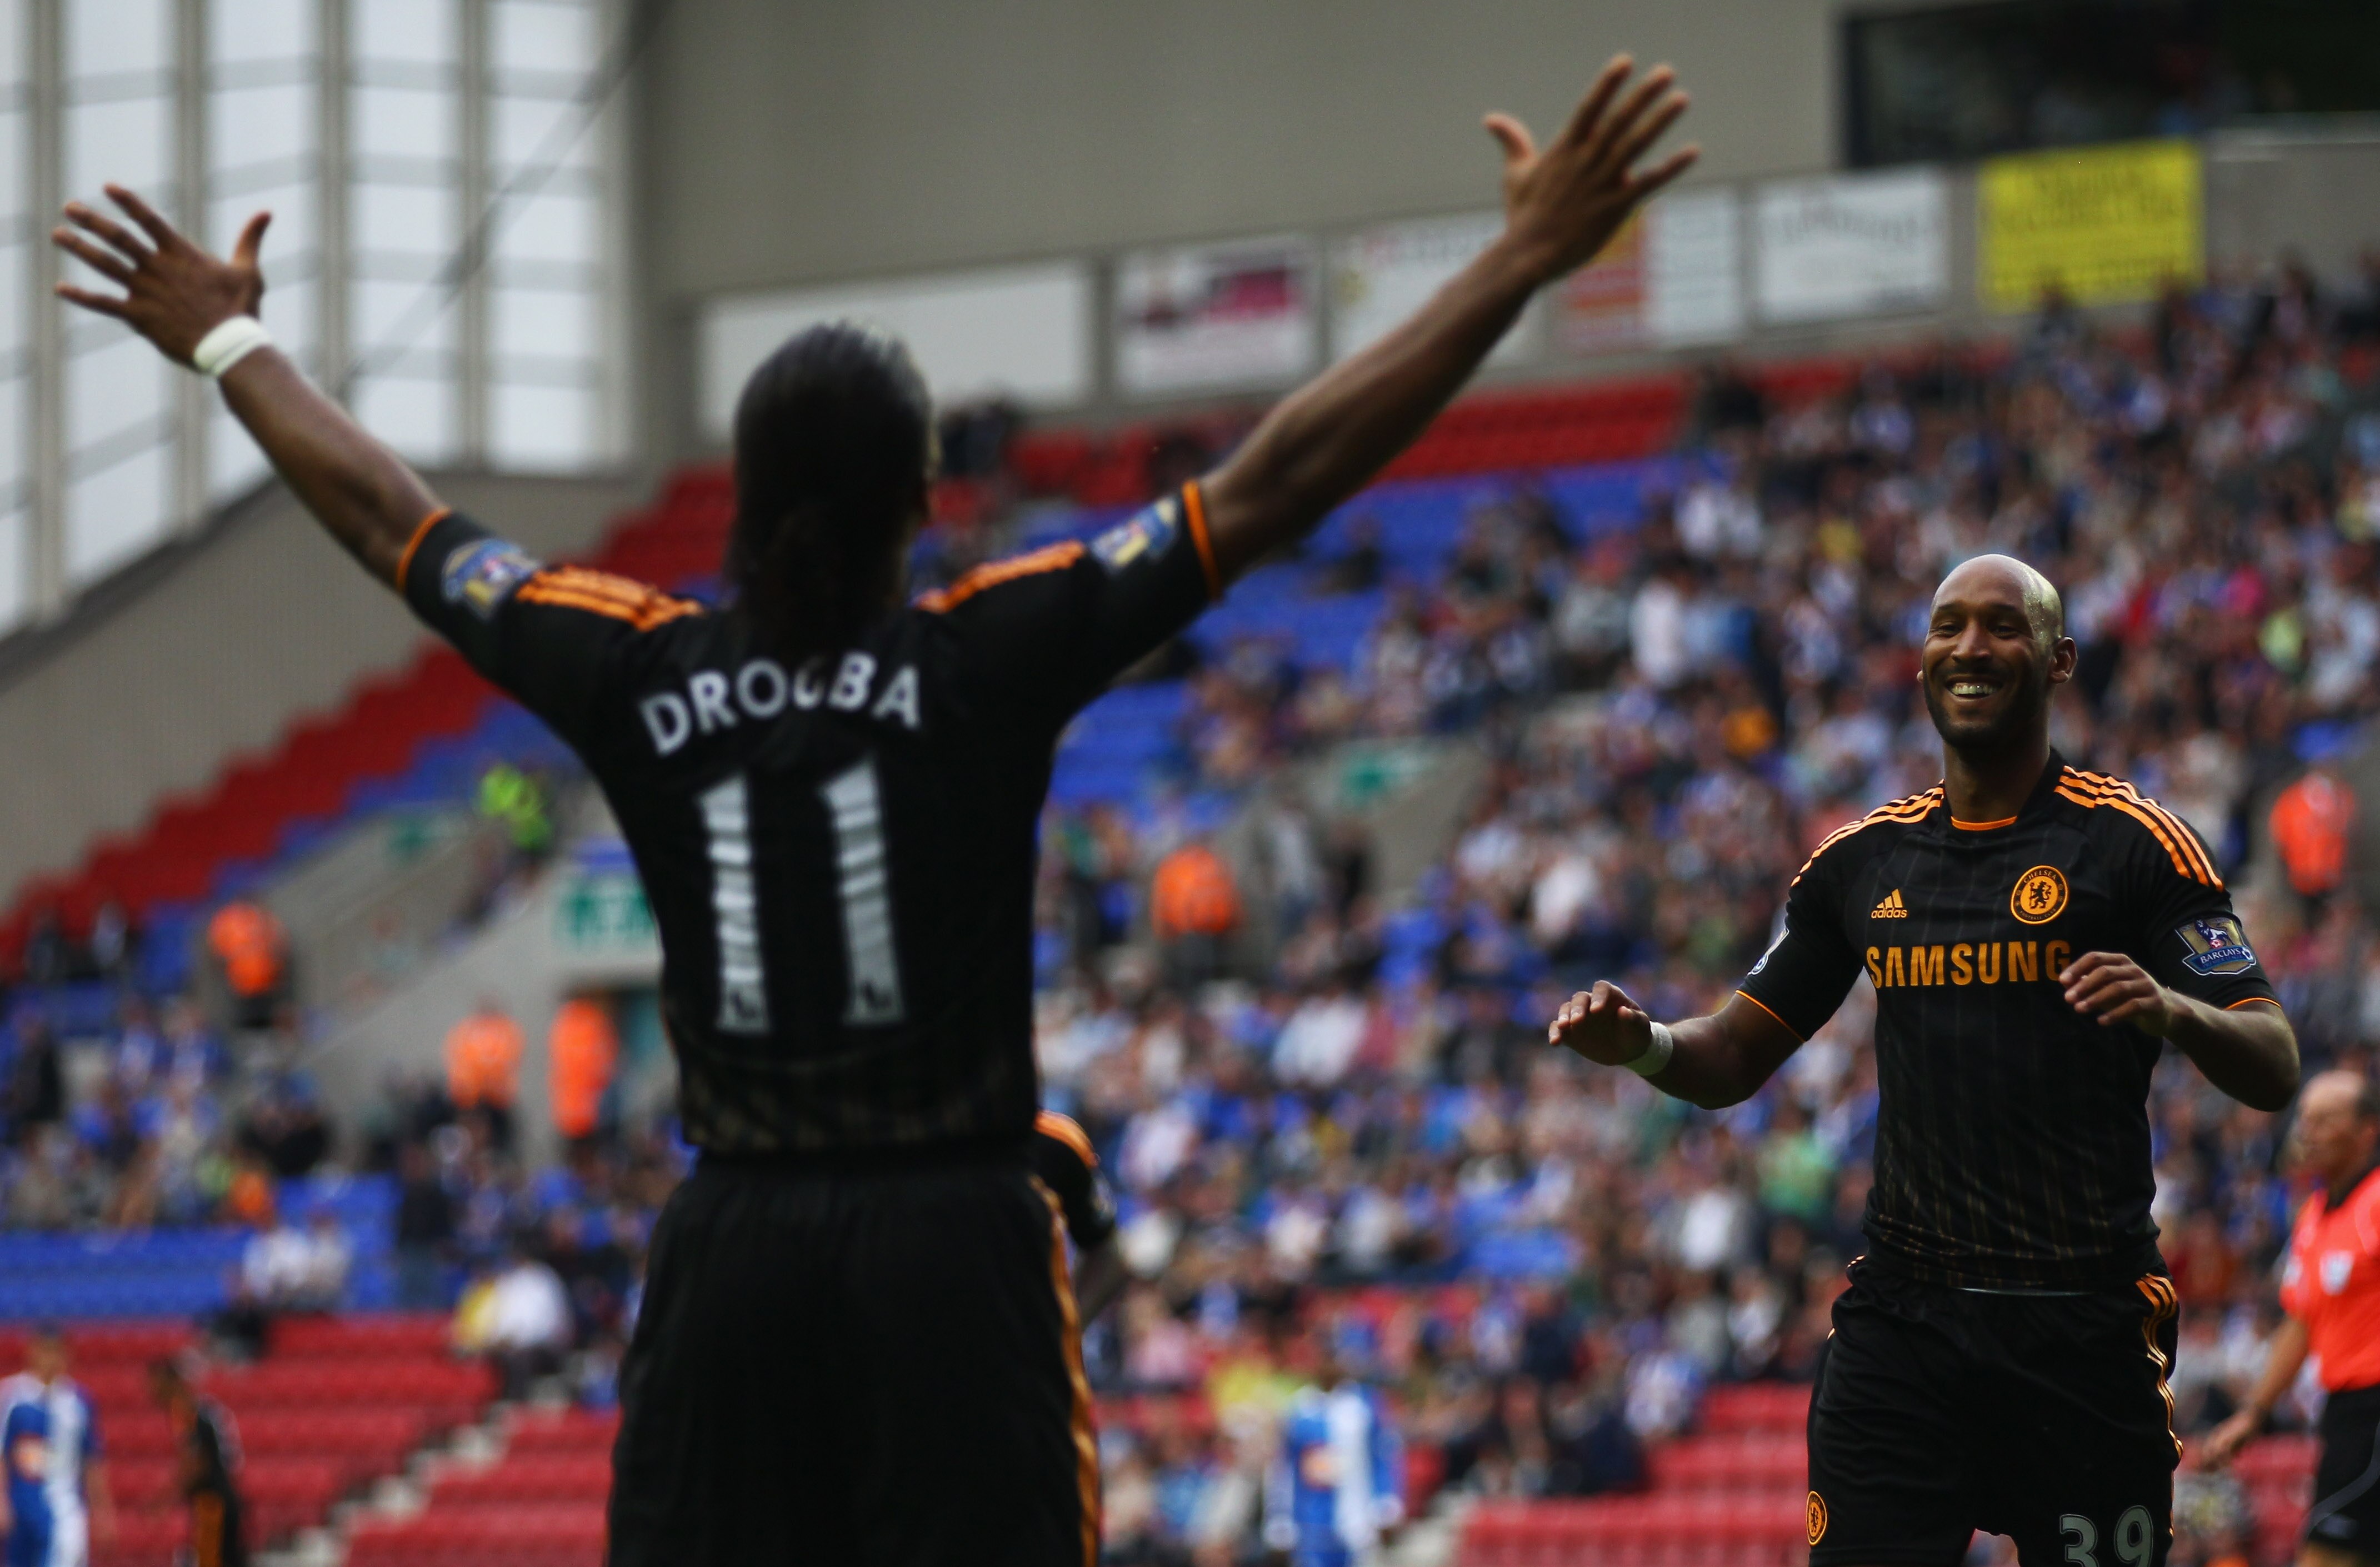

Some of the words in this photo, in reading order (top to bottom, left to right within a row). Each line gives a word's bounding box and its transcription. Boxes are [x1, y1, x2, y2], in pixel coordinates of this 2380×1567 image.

[2024, 870, 2057, 883] CHELSEA
[698, 758, 904, 1032] 11
[1871, 907, 1908, 919] adidas
[1866, 939, 2072, 989] SAMSUNG
[2200, 947, 2241, 964] BARCLAYS
[2059, 1505, 2154, 1567] 39
